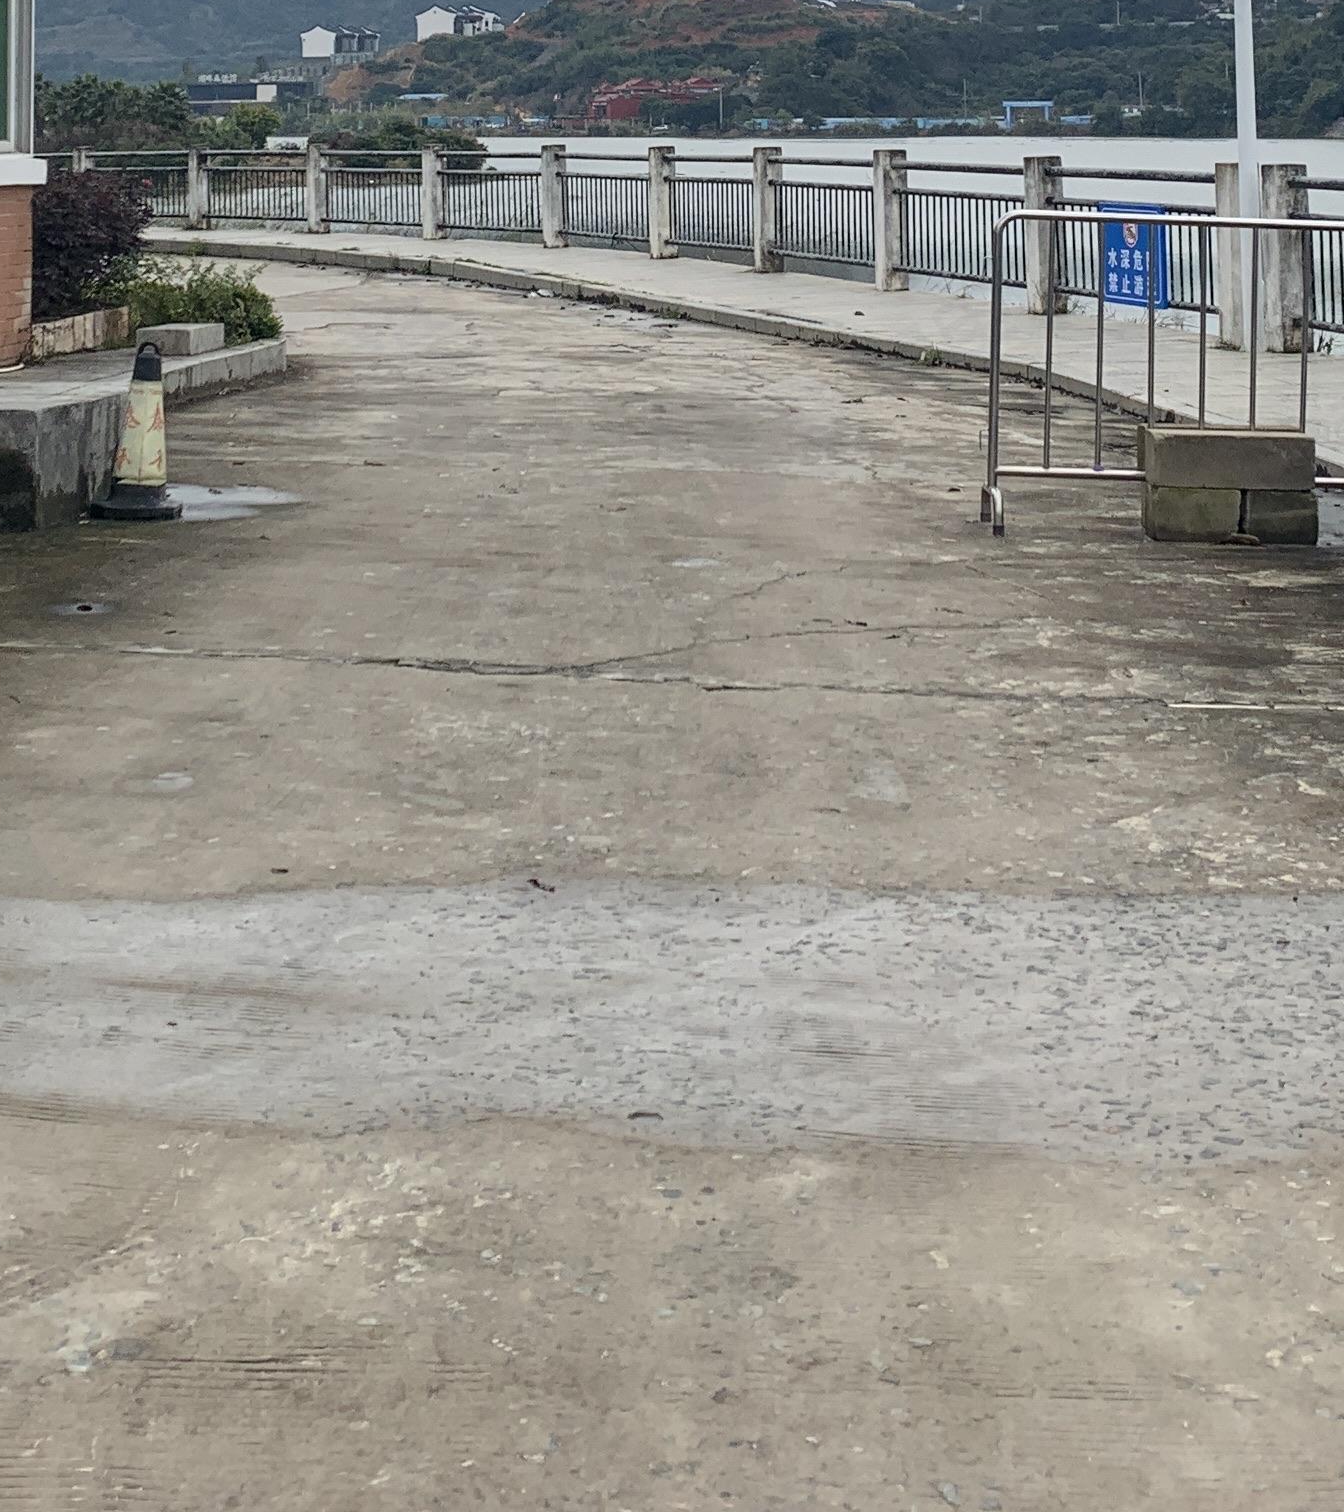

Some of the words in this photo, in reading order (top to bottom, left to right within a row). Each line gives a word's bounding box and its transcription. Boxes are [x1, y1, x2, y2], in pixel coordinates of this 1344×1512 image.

[1108, 248, 1151, 271] 水深危
[1108, 272, 1157, 297] 禁止游
